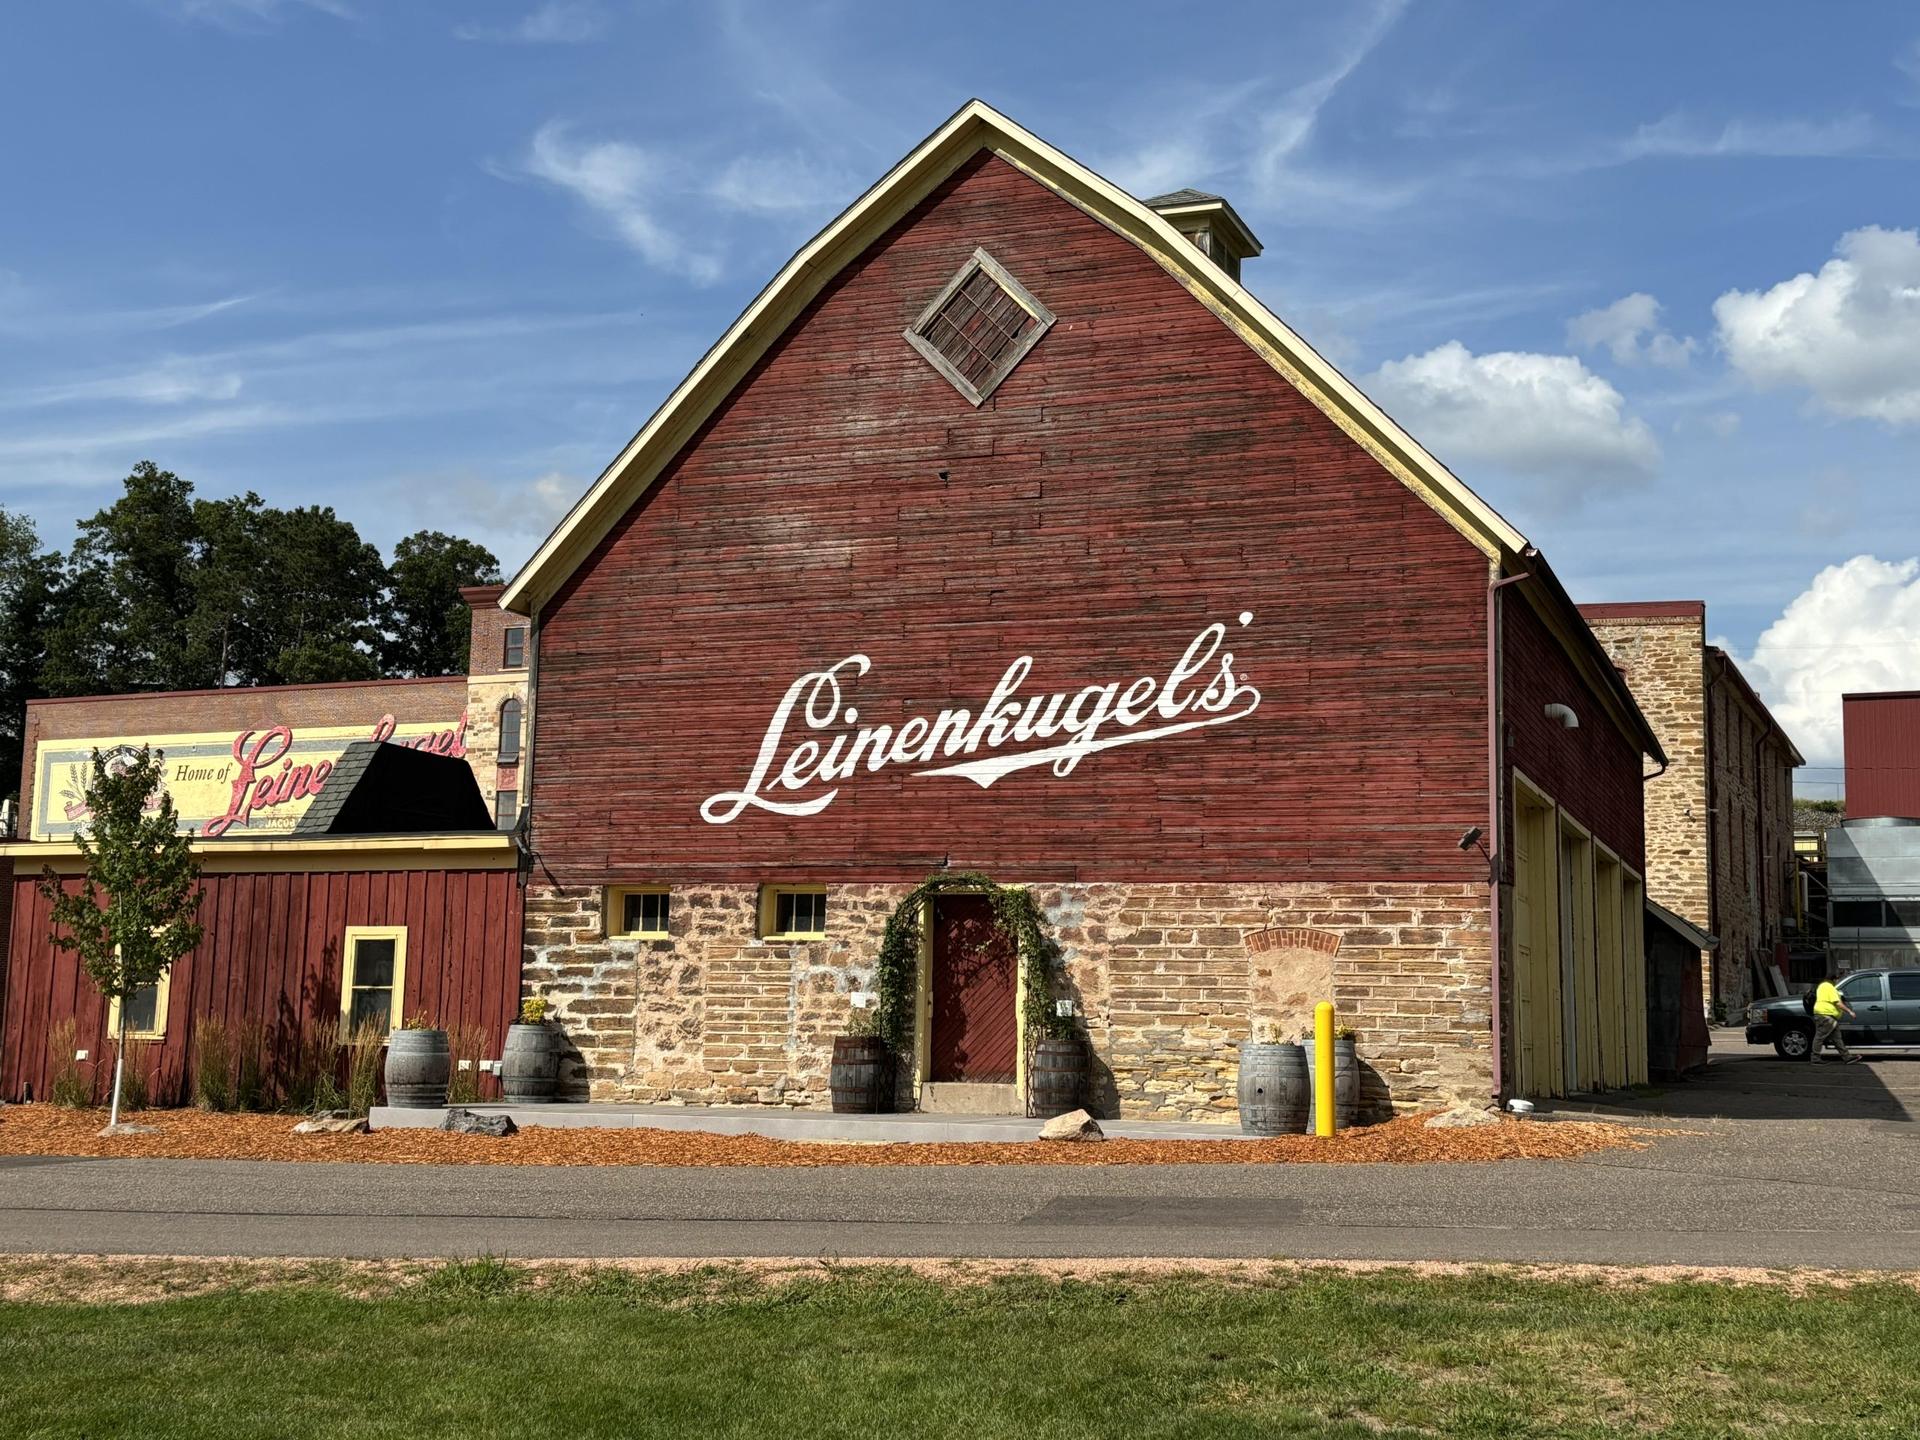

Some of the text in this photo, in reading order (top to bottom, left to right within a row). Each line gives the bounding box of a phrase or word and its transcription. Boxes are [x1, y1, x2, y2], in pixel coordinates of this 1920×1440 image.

[175, 765, 213, 781] Home
[217, 763, 232, 784] of
[700, 611, 1260, 824] Leinenkugel's
